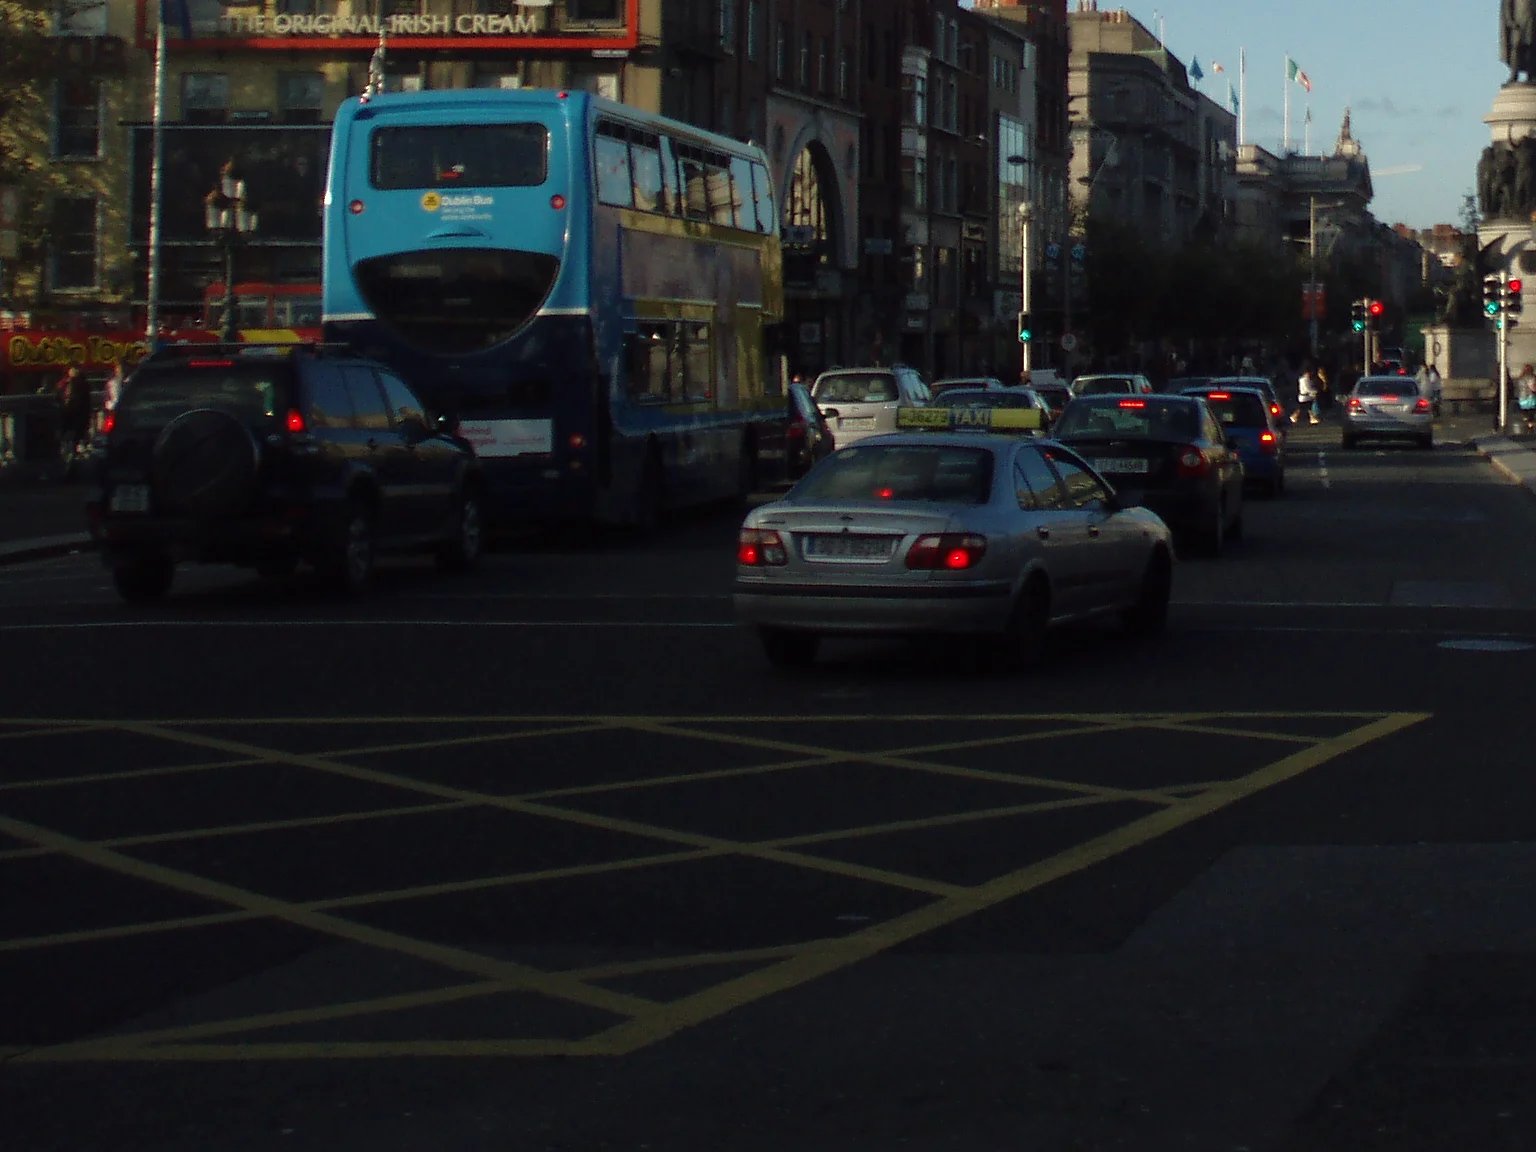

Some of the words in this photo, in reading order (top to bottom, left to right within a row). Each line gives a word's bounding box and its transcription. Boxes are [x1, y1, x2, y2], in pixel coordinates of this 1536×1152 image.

[221, 14, 264, 33] THE
[273, 13, 381, 34] ORIGINAL
[388, 13, 448, 34] IRISH
[455, 14, 537, 34] CREAM
[441, 196, 472, 206] Dublin
[473, 195, 494, 205] Bus
[9, 335, 87, 366] Dublin
[953, 408, 991, 426] TAXI
